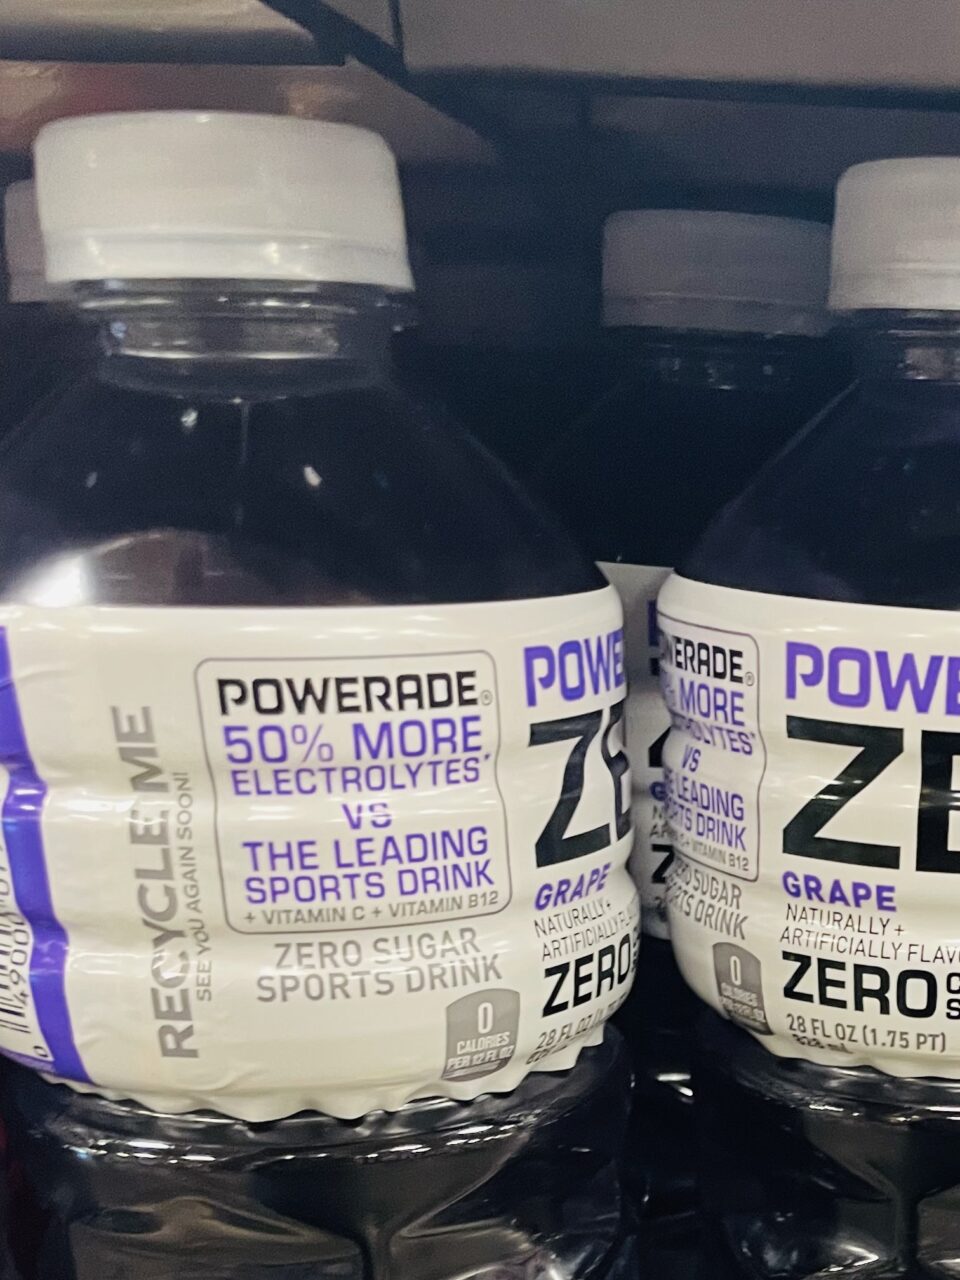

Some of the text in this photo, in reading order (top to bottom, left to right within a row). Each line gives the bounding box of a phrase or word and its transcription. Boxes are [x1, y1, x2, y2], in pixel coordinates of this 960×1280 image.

[680, 677, 745, 727] MORE
[224, 715, 482, 764] 50% MORE
[682, 744, 702, 773] VS
[342, 802, 393, 830] VS
[676, 773, 745, 821] LEADING
[242, 826, 489, 871] THE LEADING
[696, 811, 747, 851] DRINK
[111, 704, 199, 1059] RECYCLE ME
[181, 844, 203, 906] AGAIN
[245, 859, 494, 905] SPORTS DRINK
[534, 862, 612, 911] GRAPE
[693, 868, 743, 909] SUGAR
[782, 871, 897, 912] GRAPE
[262, 891, 499, 925] VITAMIN C VITAMIN B12
[534, 897, 606, 939] NATURALLY
[694, 899, 749, 940] DRINK
[785, 903, 890, 937] NATURALLY
[193, 909, 211, 957] YOU
[274, 927, 481, 971] ZERO SUGAR
[780, 926, 903, 961] ARTIFICIALLY
[196, 959, 213, 1002] SEE
[257, 954, 502, 1003] SPORTS DRINK
[541, 932, 631, 1018] ZERO
[730, 955, 742, 986] 0
[781, 950, 938, 1019] ZERO
[478, 1001, 494, 1034] 0
[786, 1013, 807, 1033] 28
[810, 1018, 831, 1038] FL
[835, 1023, 858, 1043] OZ
[862, 1025, 911, 1051] (1.75
[915, 1031, 947, 1054] PT)
[456, 1031, 511, 1055] CALORIES
